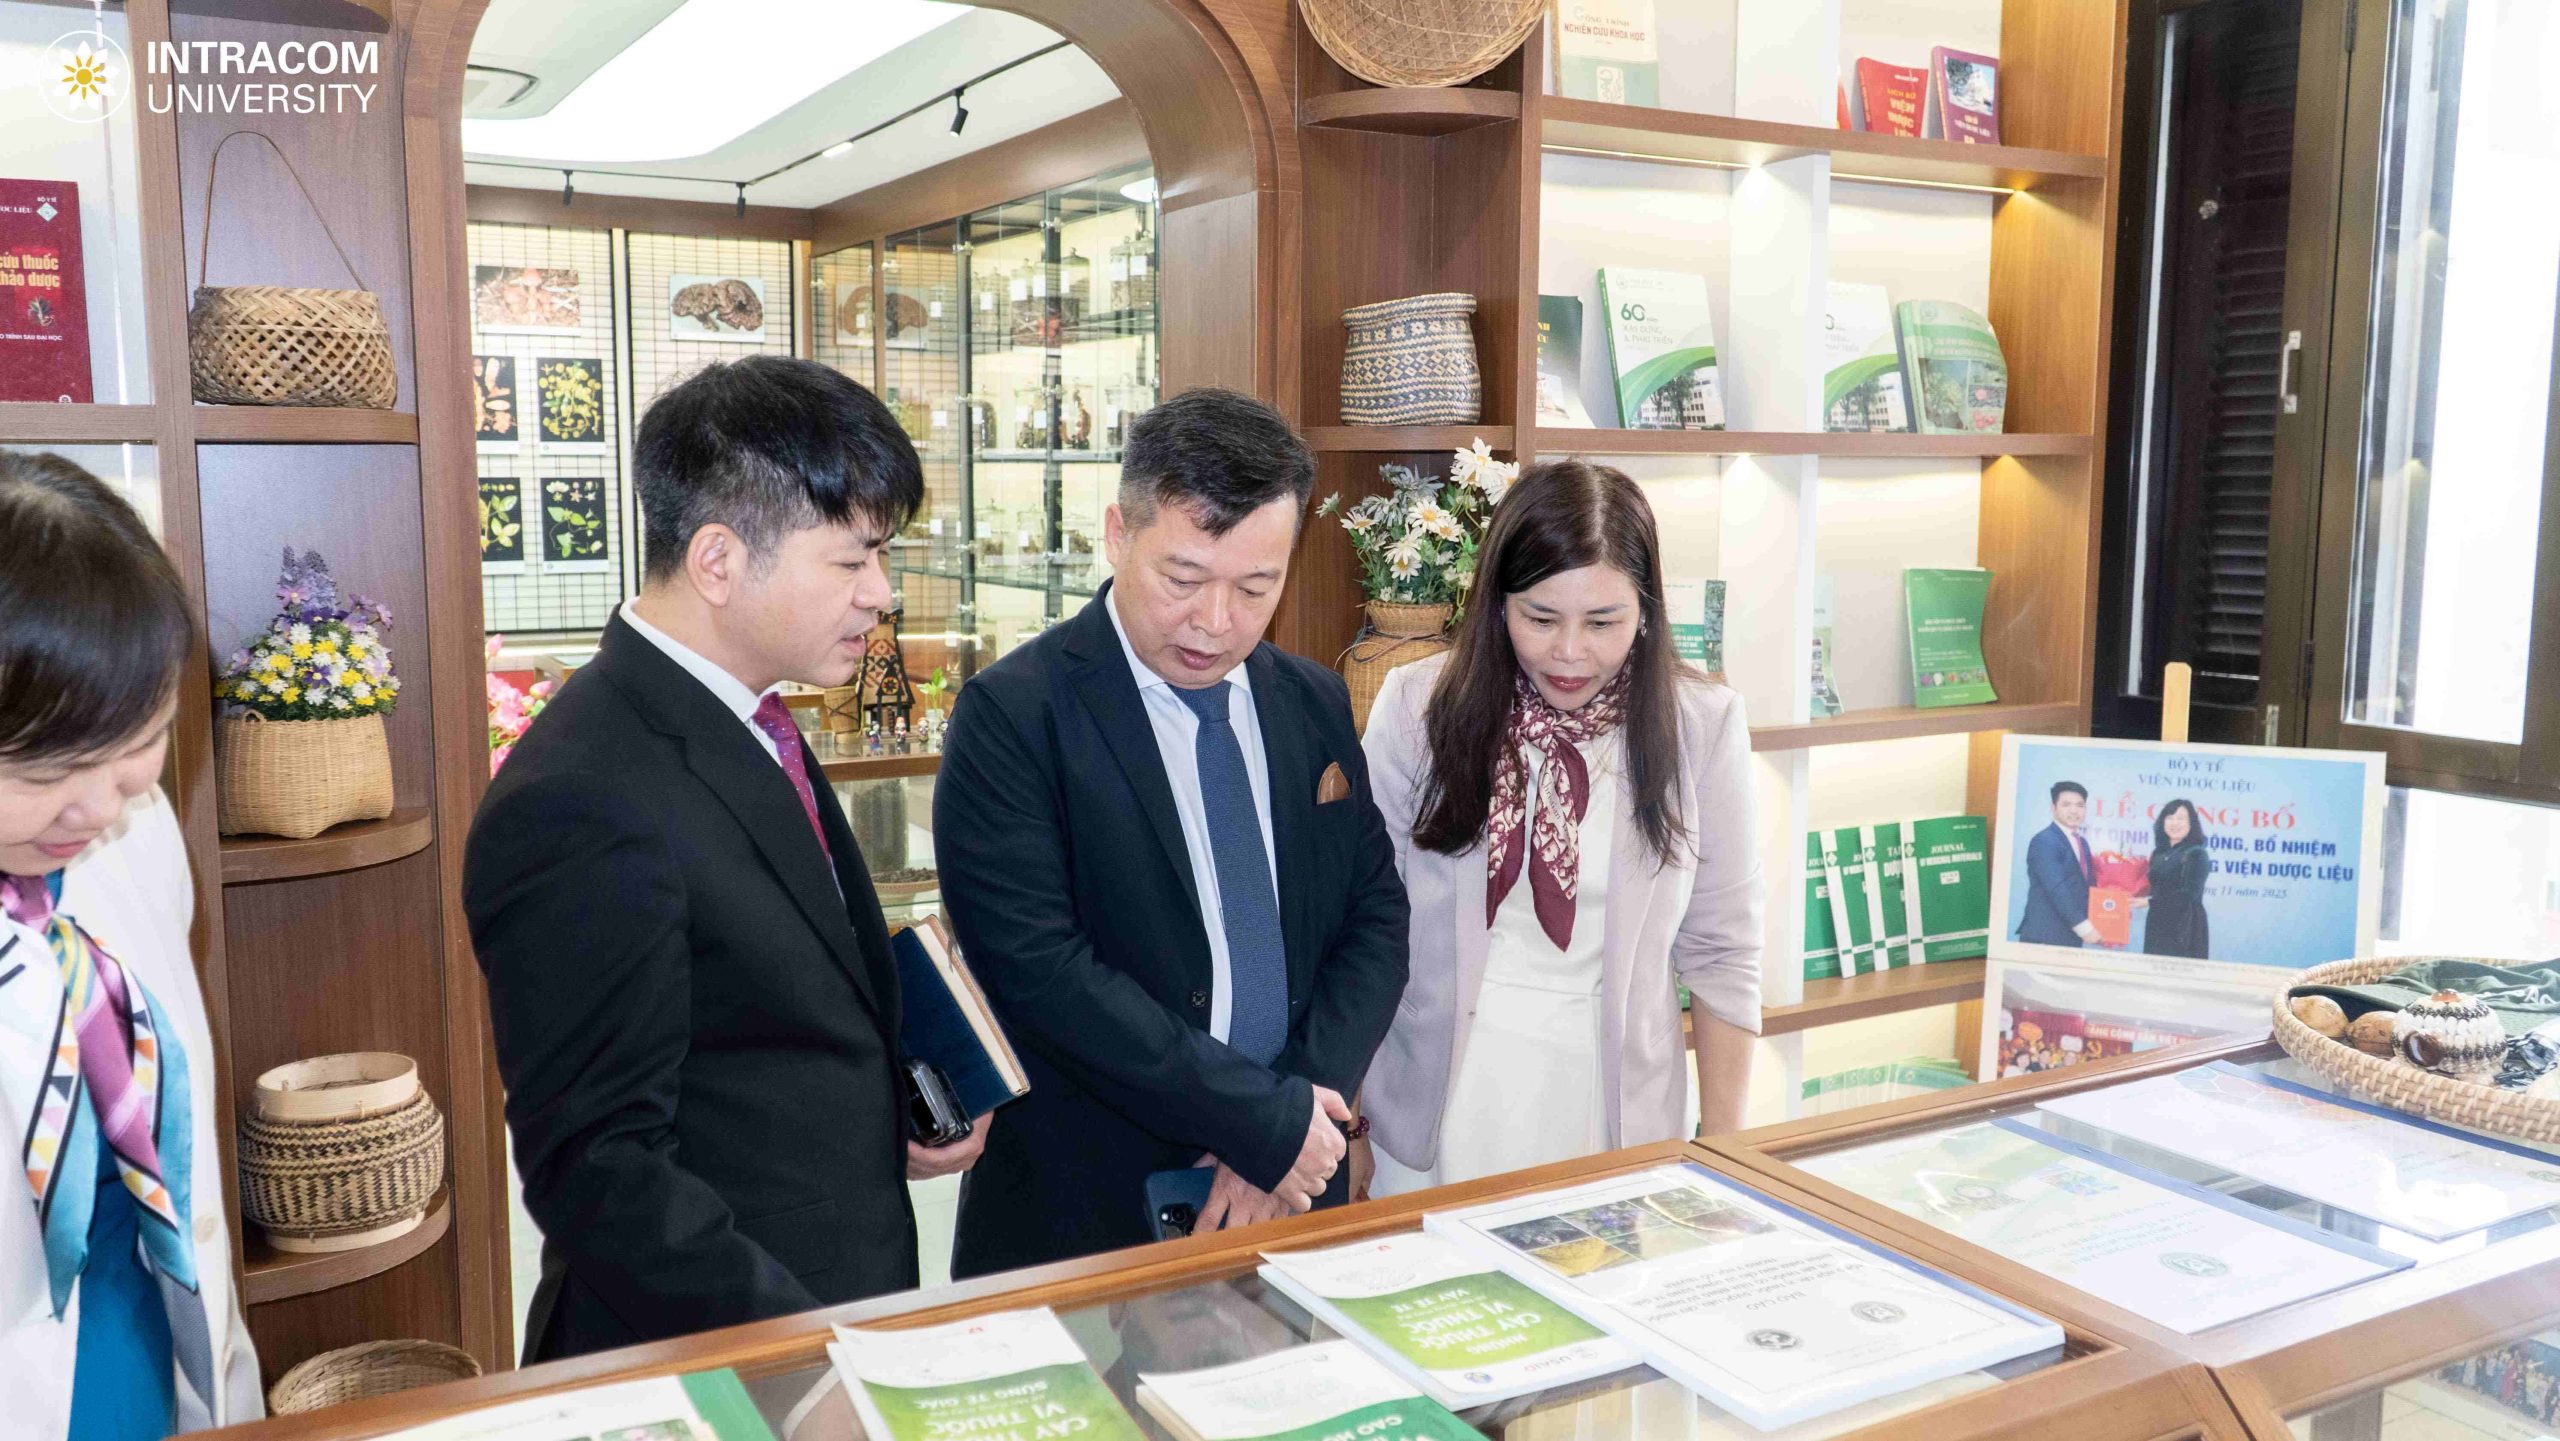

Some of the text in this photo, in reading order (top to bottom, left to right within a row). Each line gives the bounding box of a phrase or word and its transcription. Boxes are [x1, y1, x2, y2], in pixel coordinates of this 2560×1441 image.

[22, 253, 59, 270] thuốc
[0, 269, 60, 290] hảo dược
[1621, 303, 1645, 322] 60
[2168, 757, 2226, 773] BỘ Y TẾ
[2139, 774, 2173, 787] VIỆN
[2177, 777, 2219, 791] DƯỢC
[2252, 802, 2296, 830] BỐ
[2282, 840, 2336, 857] NHIỆM
[2225, 858, 2262, 877] VIỆN
[2268, 863, 2312, 881] DƯỢC
[2318, 864, 2353, 883] LIỆU
[1401, 1309, 1484, 1335] THUỐC
[1411, 1312, 1542, 1350] CÂY THUỐC
[1356, 1415, 1403, 1436] CAO
